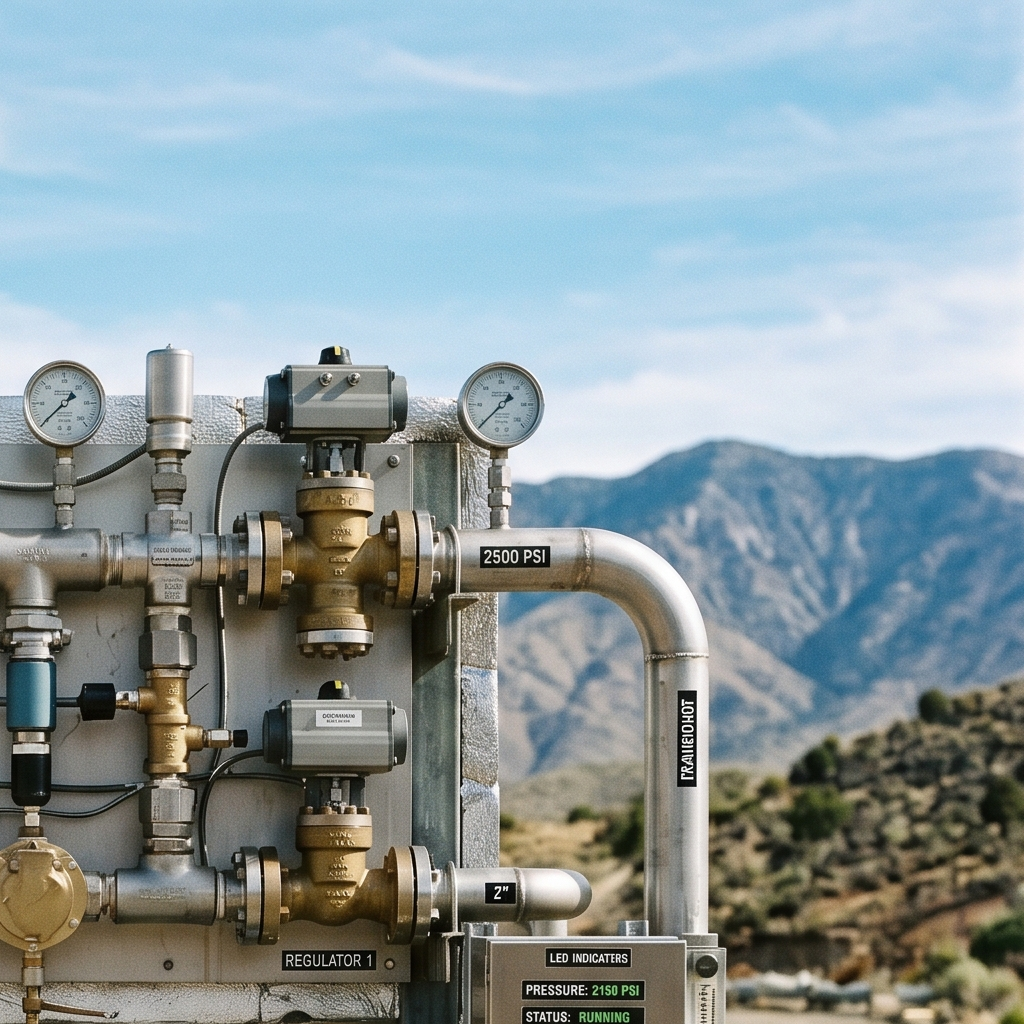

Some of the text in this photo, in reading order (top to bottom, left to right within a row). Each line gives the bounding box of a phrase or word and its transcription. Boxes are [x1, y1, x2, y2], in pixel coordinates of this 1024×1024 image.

[484, 549, 546, 564] 2500 PSI
[493, 885, 509, 900] 2"
[285, 953, 372, 968] REGULATOR 1
[549, 952, 569, 965] LED
[526, 984, 640, 997] PRESSURE: 2150 PSI
[525, 1011, 630, 1024] STATUS: RUNNING
